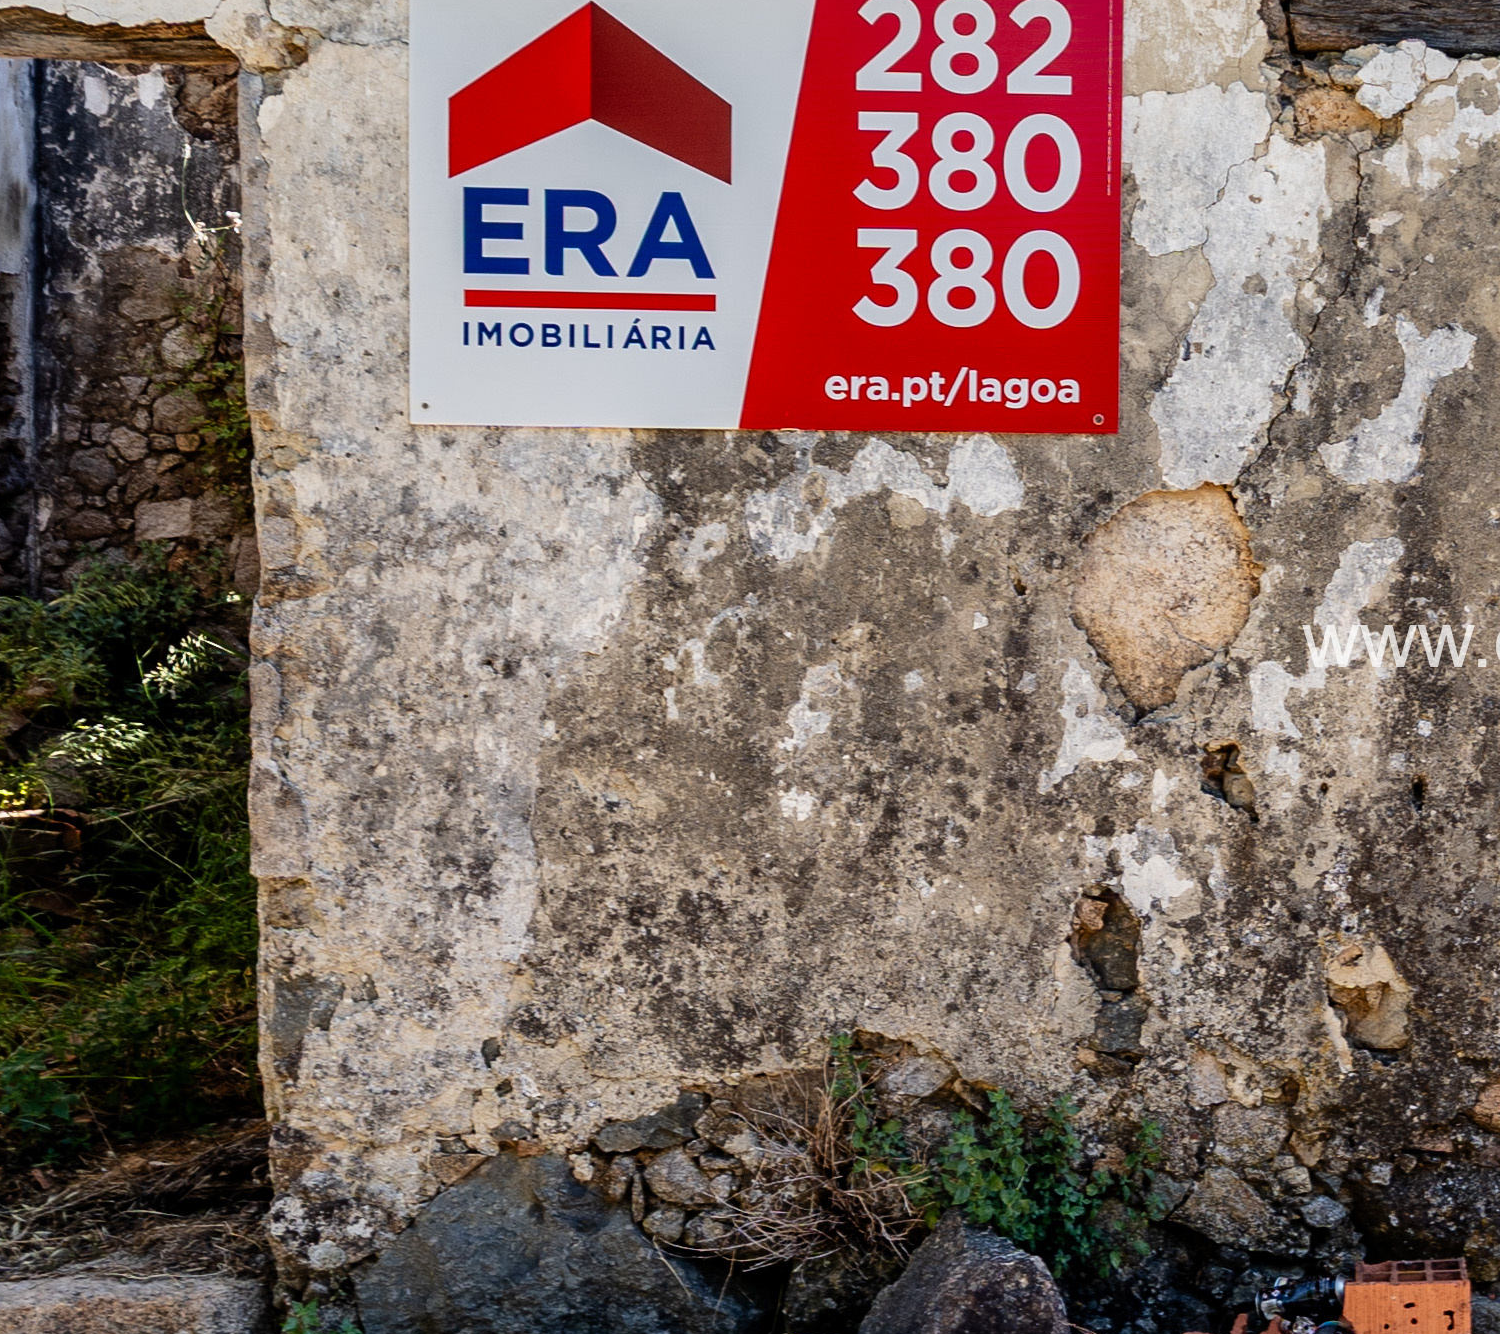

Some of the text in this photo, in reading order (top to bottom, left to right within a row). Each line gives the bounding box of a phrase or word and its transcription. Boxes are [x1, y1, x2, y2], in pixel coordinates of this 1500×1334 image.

[852, 111, 1082, 213] 380
[462, 186, 716, 279] ERA
[852, 229, 1081, 329] 380
[462, 318, 716, 351] IMOBILIÁRIA
[824, 366, 1080, 409] era.pt/lagoa
